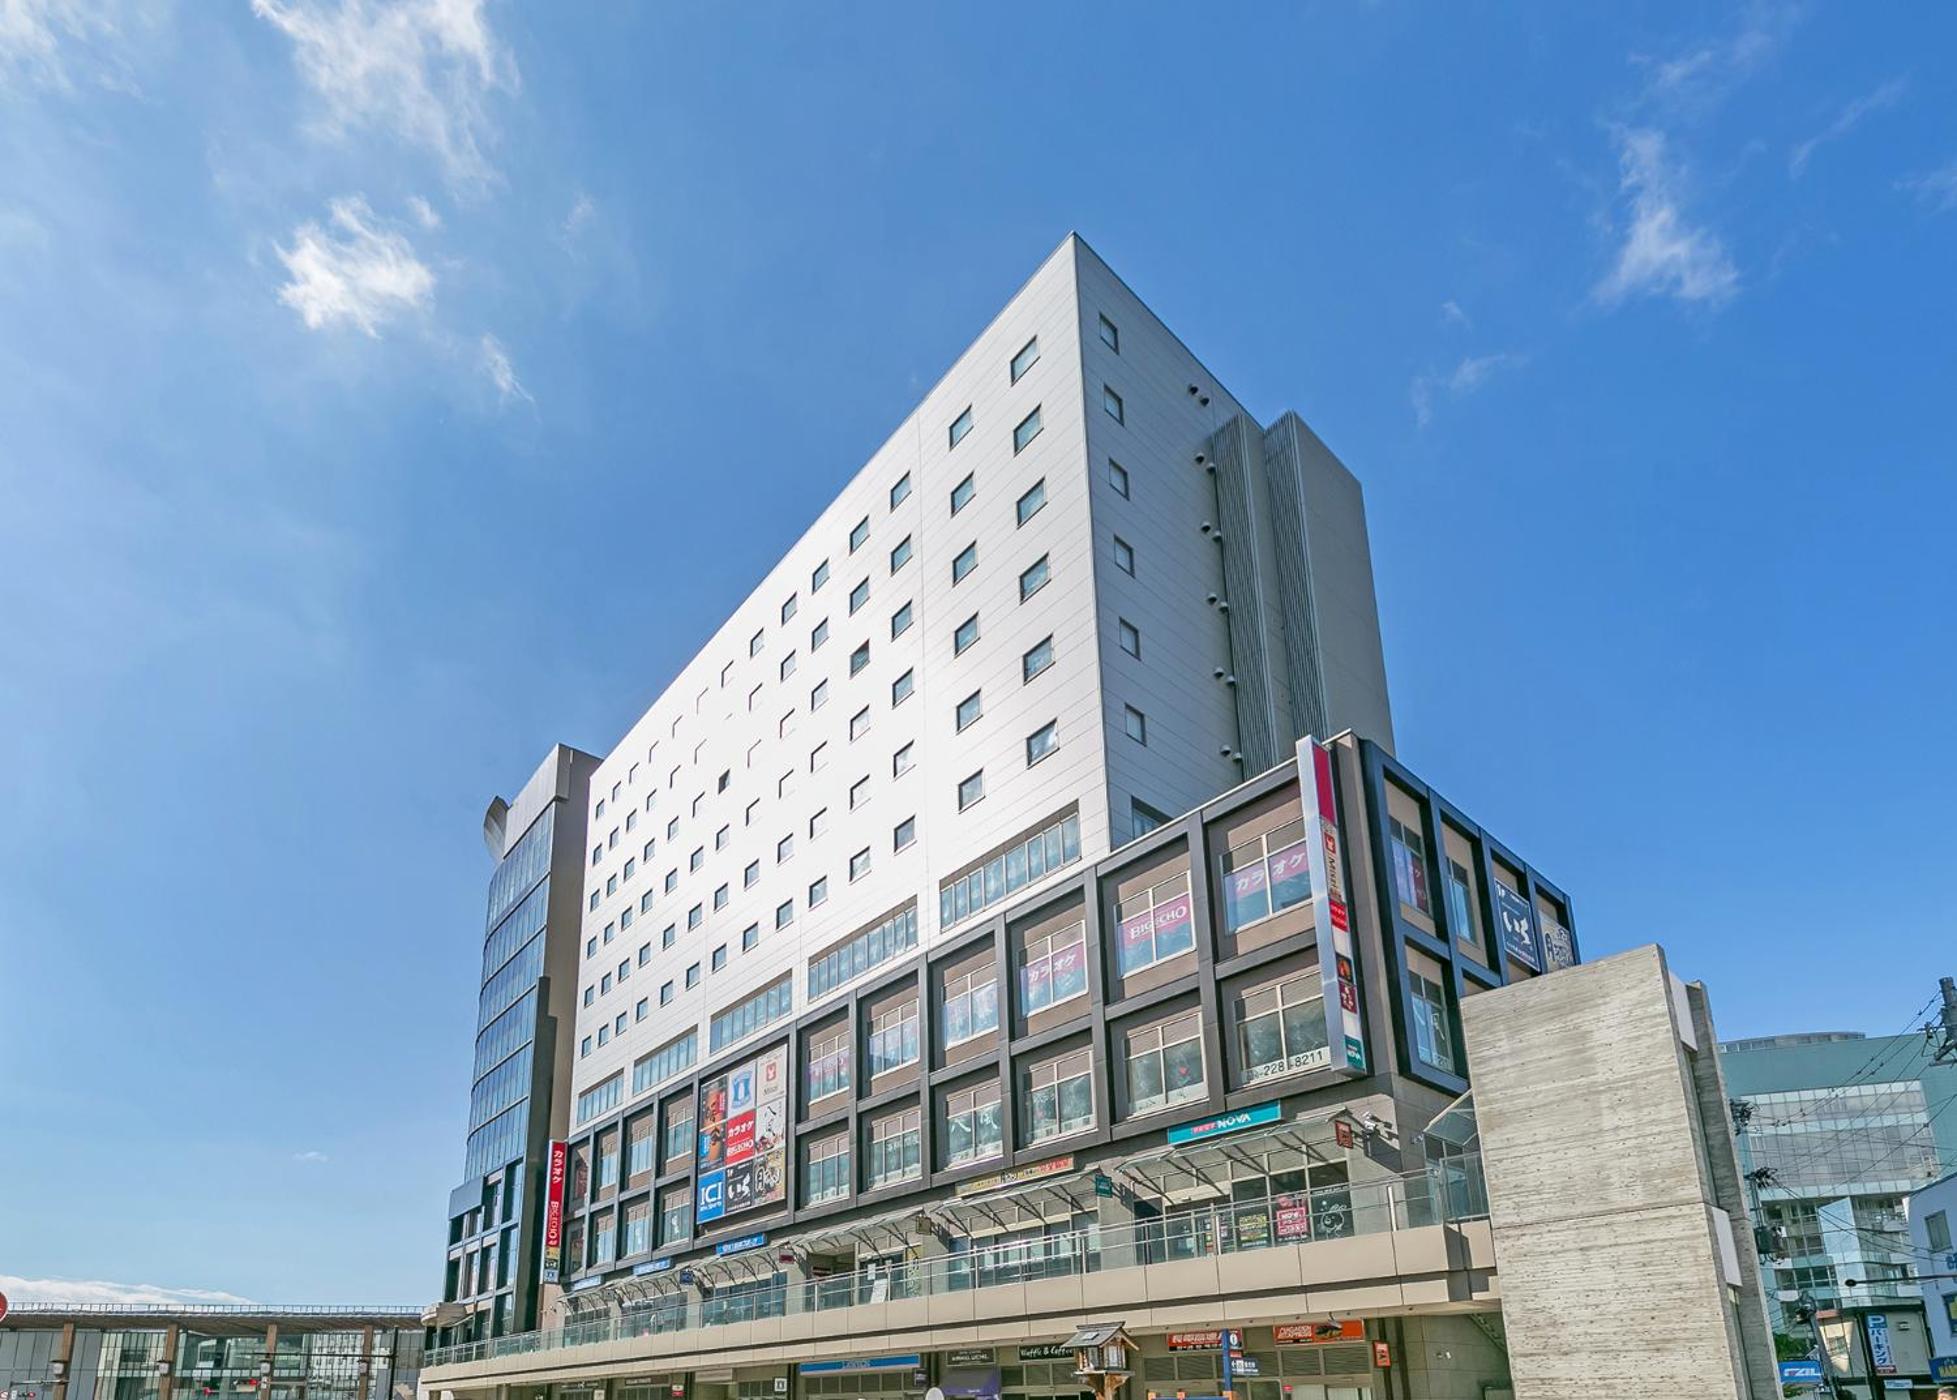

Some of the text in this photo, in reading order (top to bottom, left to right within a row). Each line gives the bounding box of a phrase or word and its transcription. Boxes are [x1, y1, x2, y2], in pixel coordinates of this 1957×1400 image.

[1235, 852, 1306, 892] カラオケ
[1029, 953, 1077, 984] カラオケ
[1216, 1113, 1252, 1129] NOVA
[701, 1182, 722, 1206] ICI
